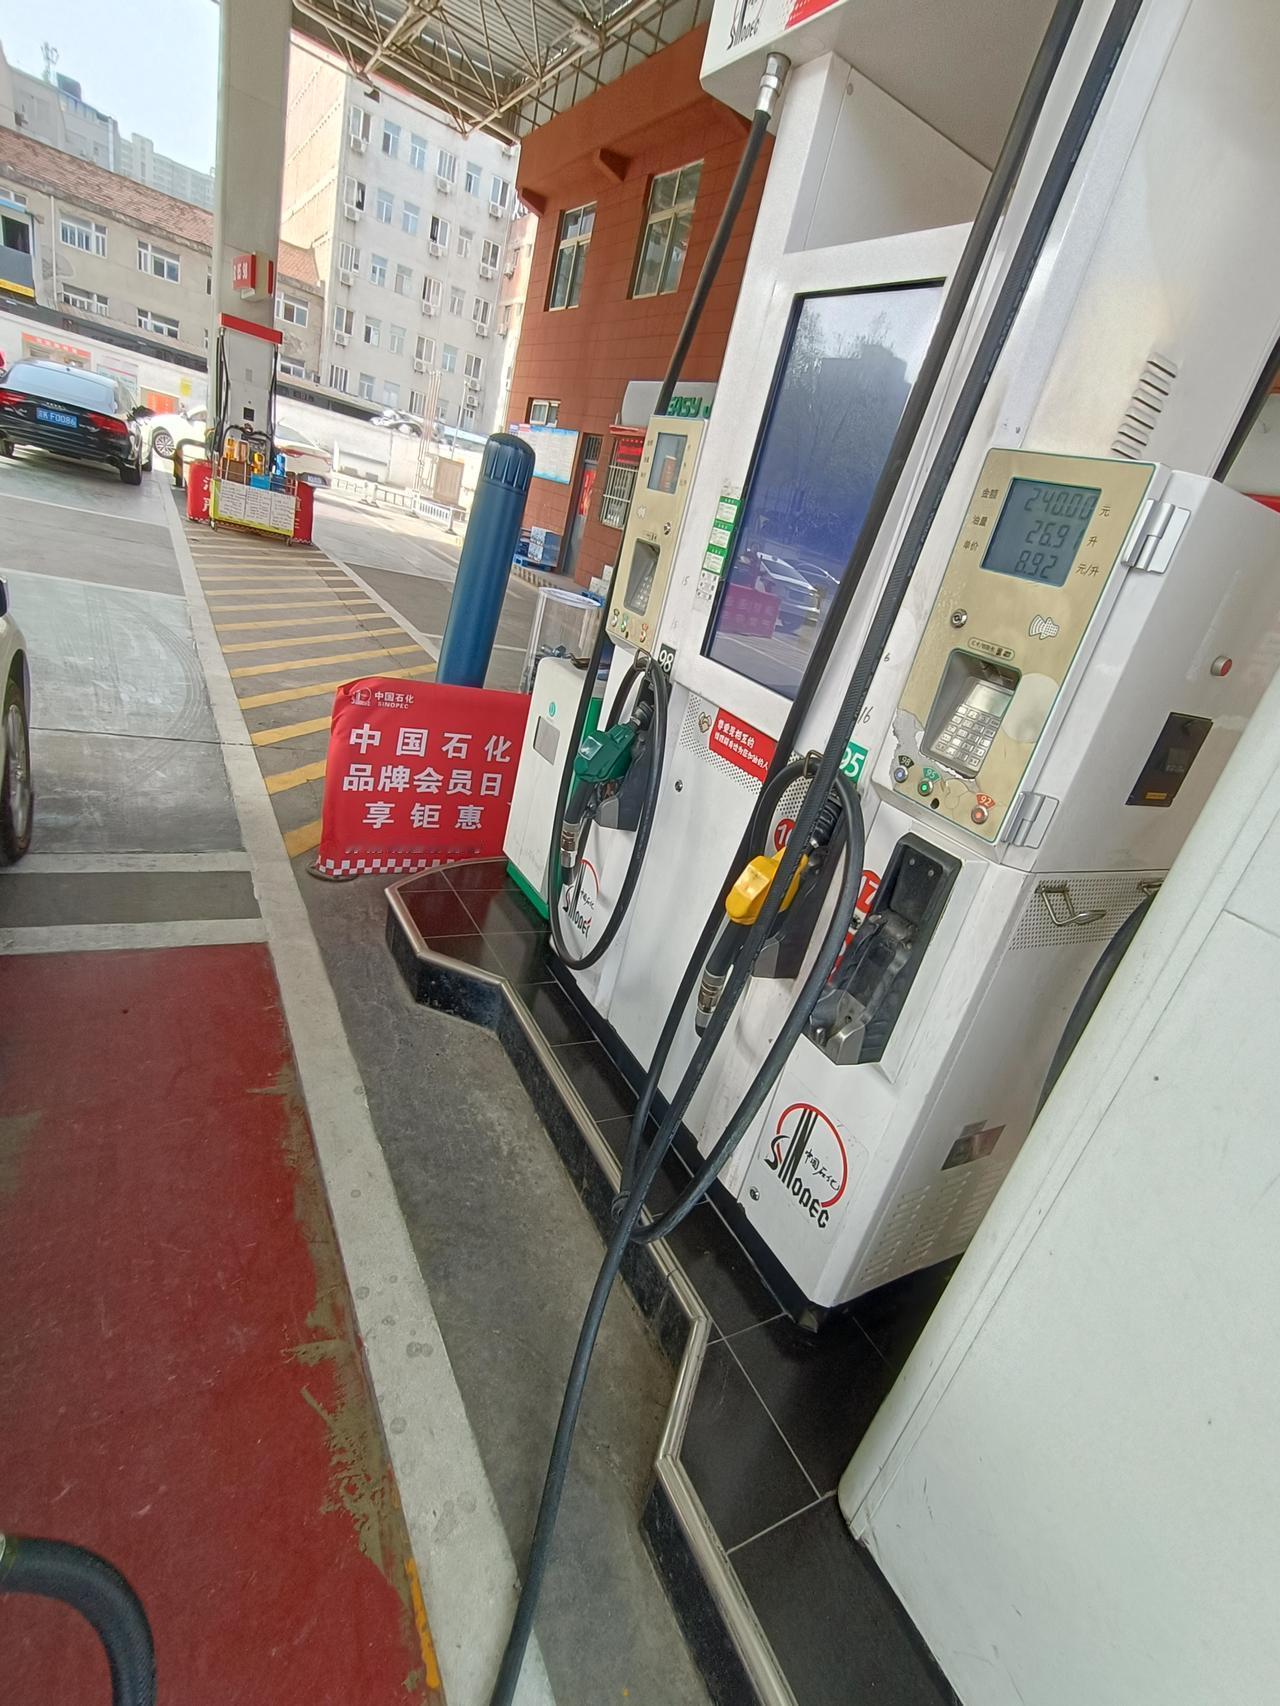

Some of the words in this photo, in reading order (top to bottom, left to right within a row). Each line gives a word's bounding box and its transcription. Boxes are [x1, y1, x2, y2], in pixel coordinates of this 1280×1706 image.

[981, 488, 999, 499] 金额
[1024, 488, 1098, 520] 240.00
[1098, 505, 1111, 517] 元
[971, 515, 989, 527] 油量
[1086, 536, 1098, 547] 升
[1014, 551, 1058, 579] 8.92
[1075, 564, 1099, 577] 元/升
[659, 650, 674, 673] 98
[374, 691, 415, 704] 中国石化
[377, 701, 409, 709] SINOPEC
[857, 706, 874, 725] 16
[349, 723, 512, 763] 中国石化
[899, 756, 911, 767] 98
[926, 768, 937, 779] 95
[342, 764, 503, 797] 品牌会员日
[979, 794, 992, 807] 92
[362, 801, 485, 830] 享钜惠
[763, 1108, 829, 1228] SINOPEC
